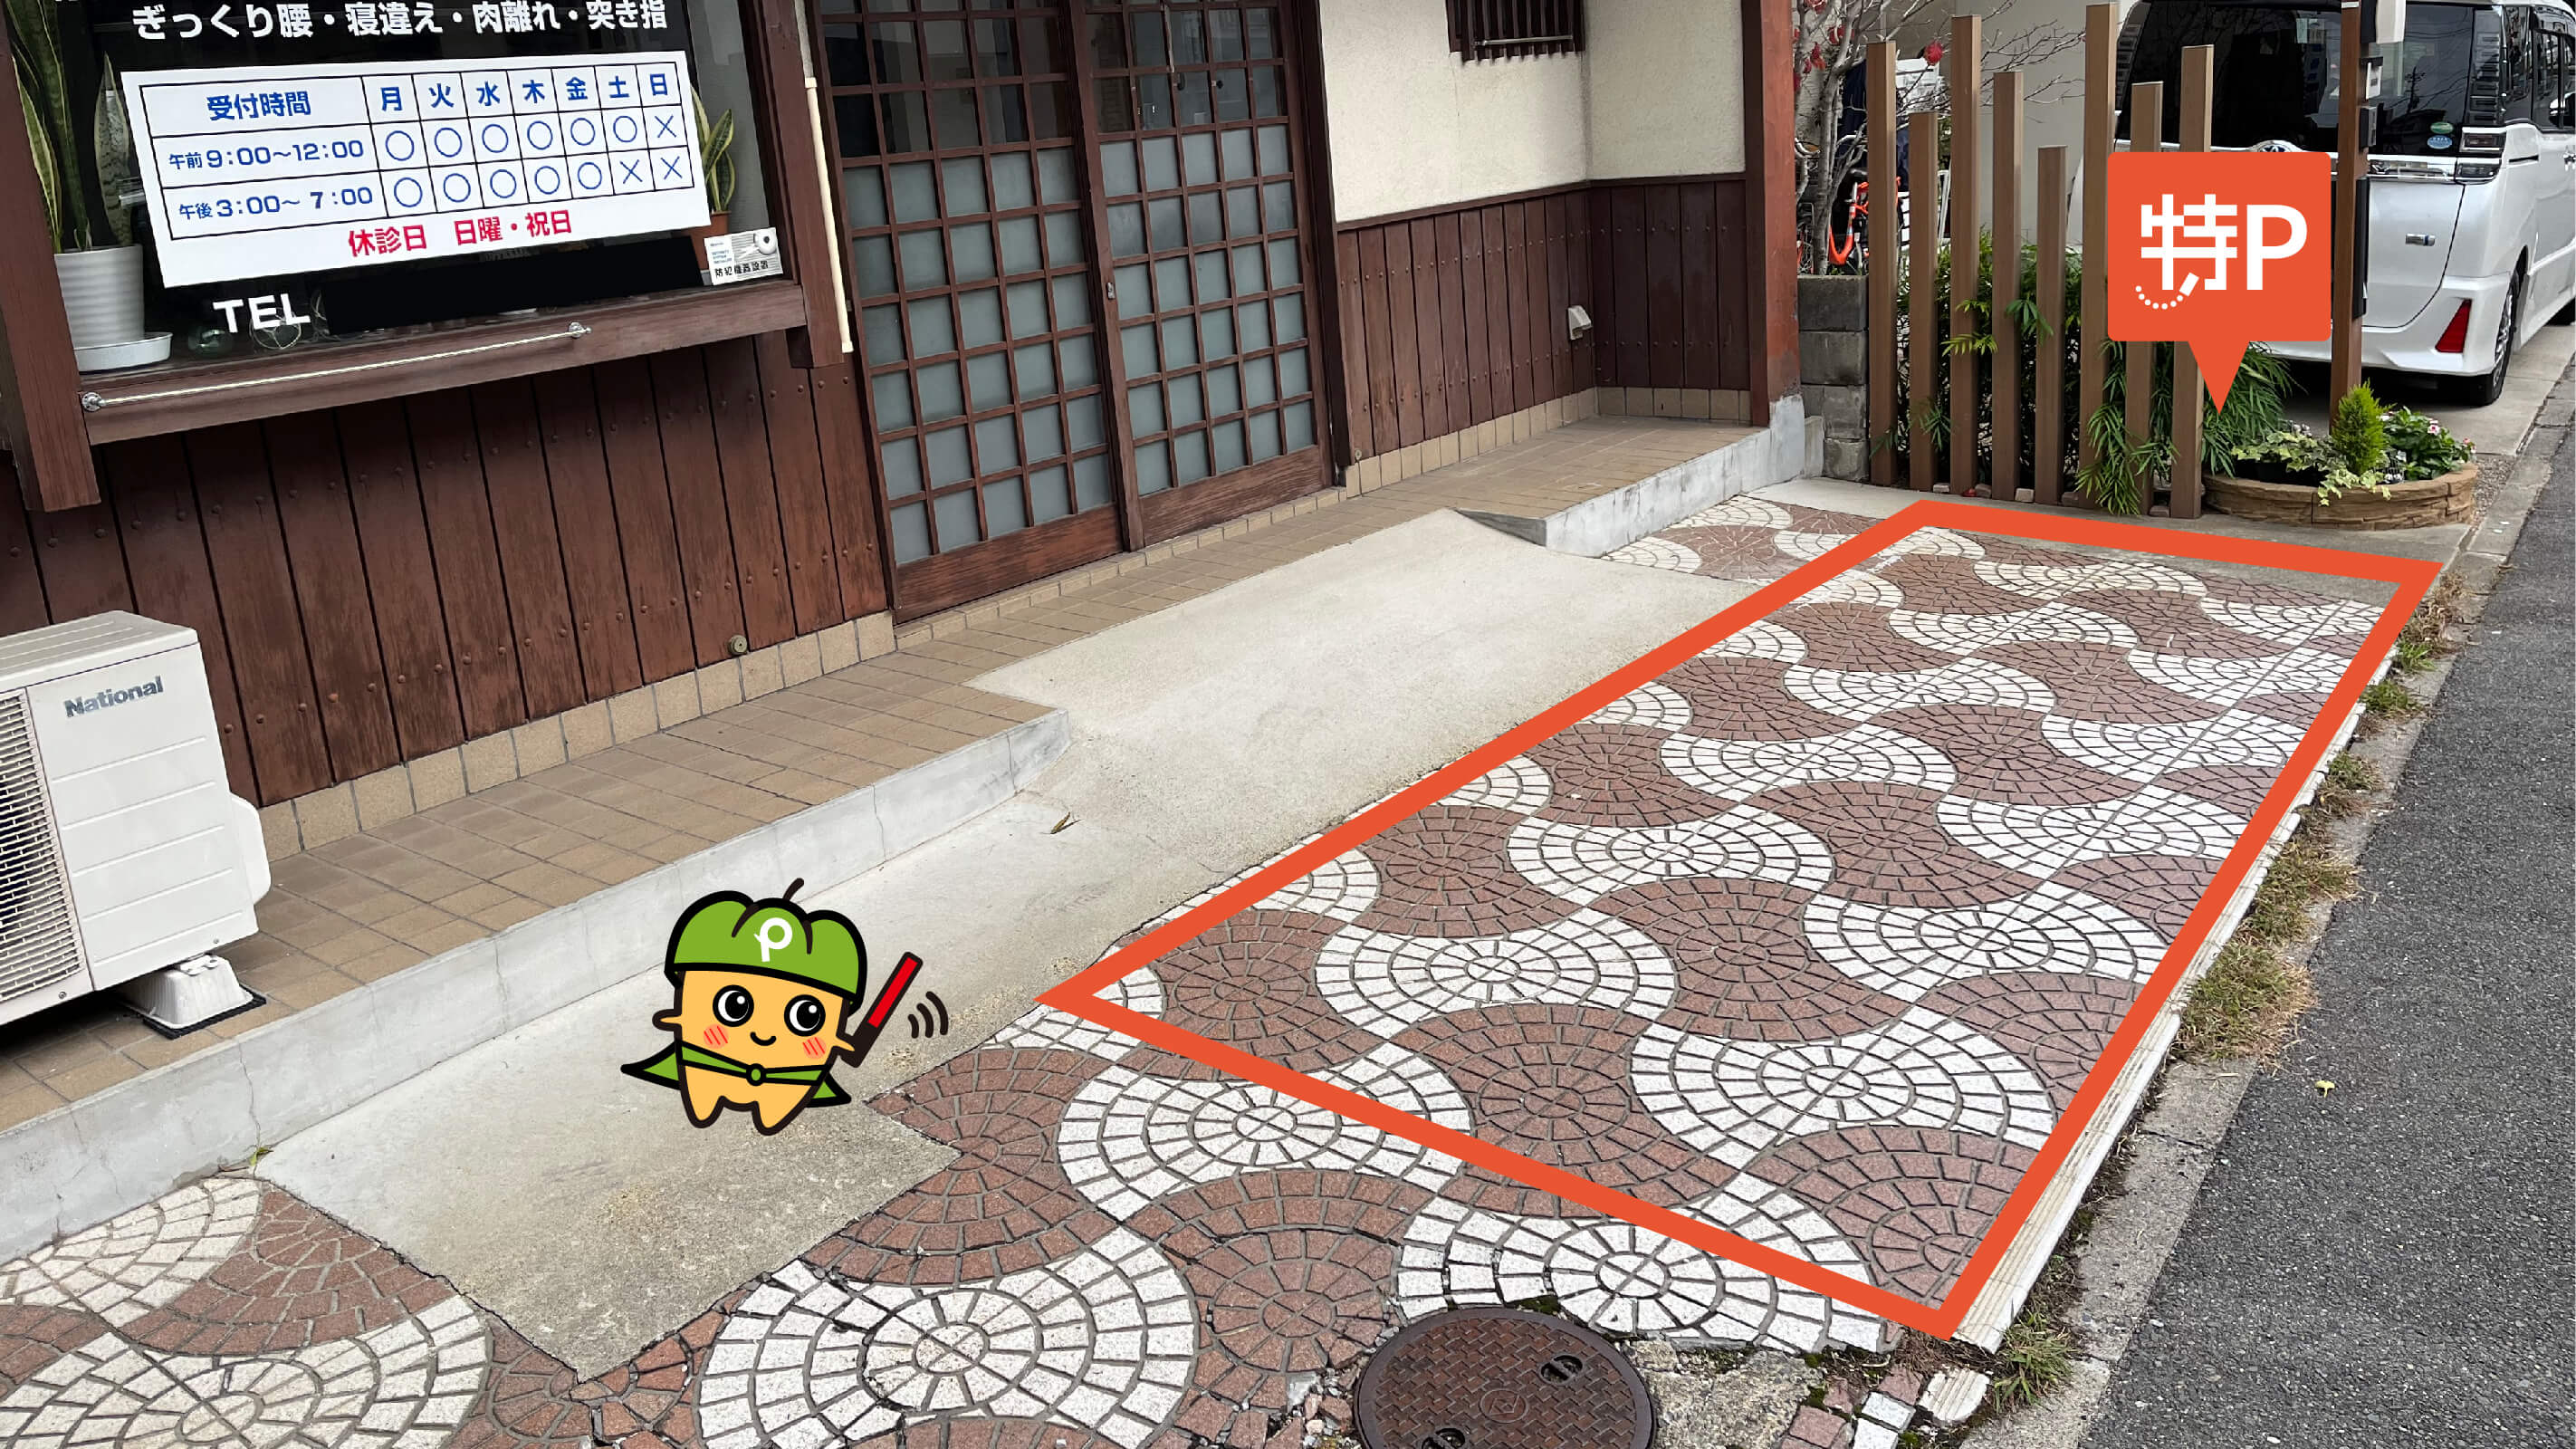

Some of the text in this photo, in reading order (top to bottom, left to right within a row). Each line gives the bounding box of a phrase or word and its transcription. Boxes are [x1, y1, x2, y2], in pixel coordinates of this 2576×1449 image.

[207, 73, 668, 120] 受付時間 月 火 水 木 金 土 日
[349, 210, 571, 257] 休診日 日曜・祝日
[212, 293, 311, 333] TEL
[63, 675, 164, 718] National
